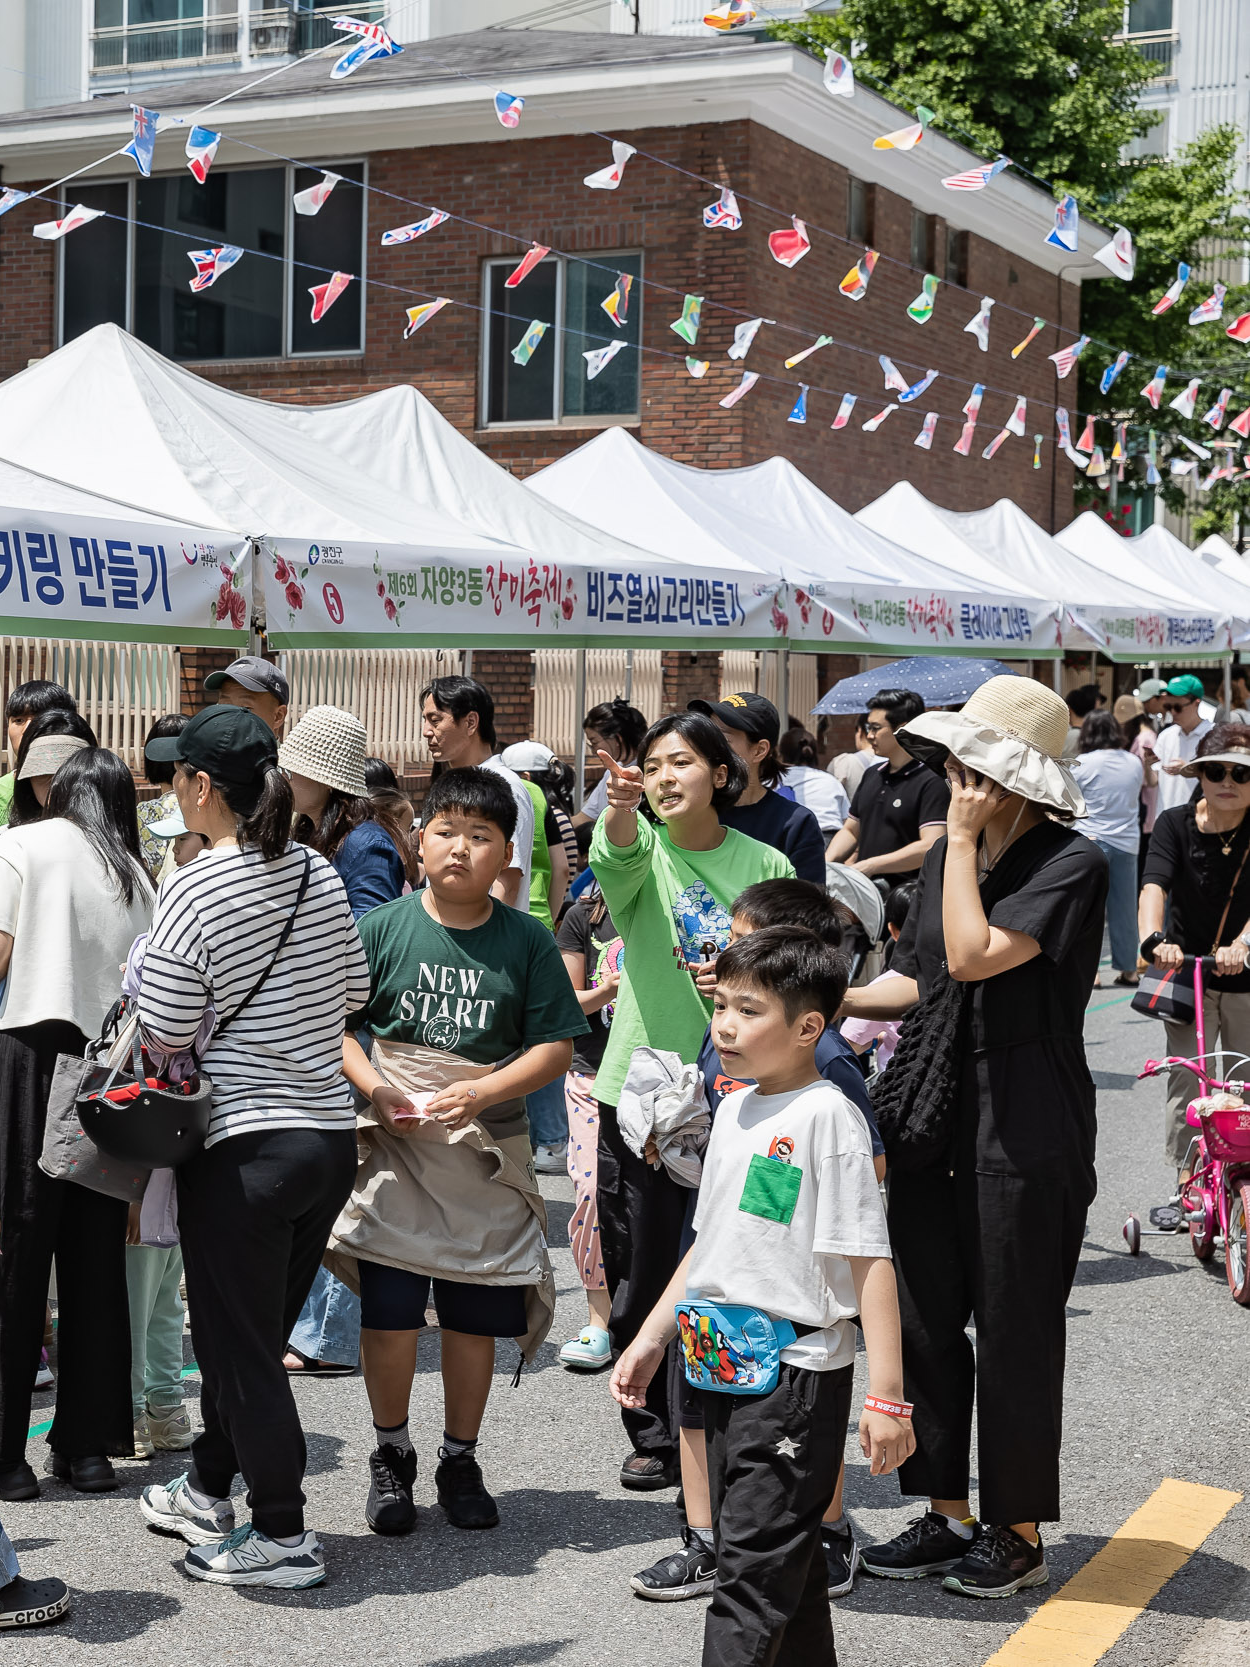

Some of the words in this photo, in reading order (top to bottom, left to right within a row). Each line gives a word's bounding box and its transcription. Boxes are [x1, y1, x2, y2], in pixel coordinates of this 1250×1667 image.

[68, 536, 172, 612] 만들기
[387, 572, 418, 598] 제6회
[420, 566, 484, 606] 자양3동
[486, 557, 562, 628] 장미축제
[325, 587, 341, 621] 5
[417, 962, 485, 997] NEW
[399, 990, 495, 1030] START
[14, 1602, 63, 1624] crocs
